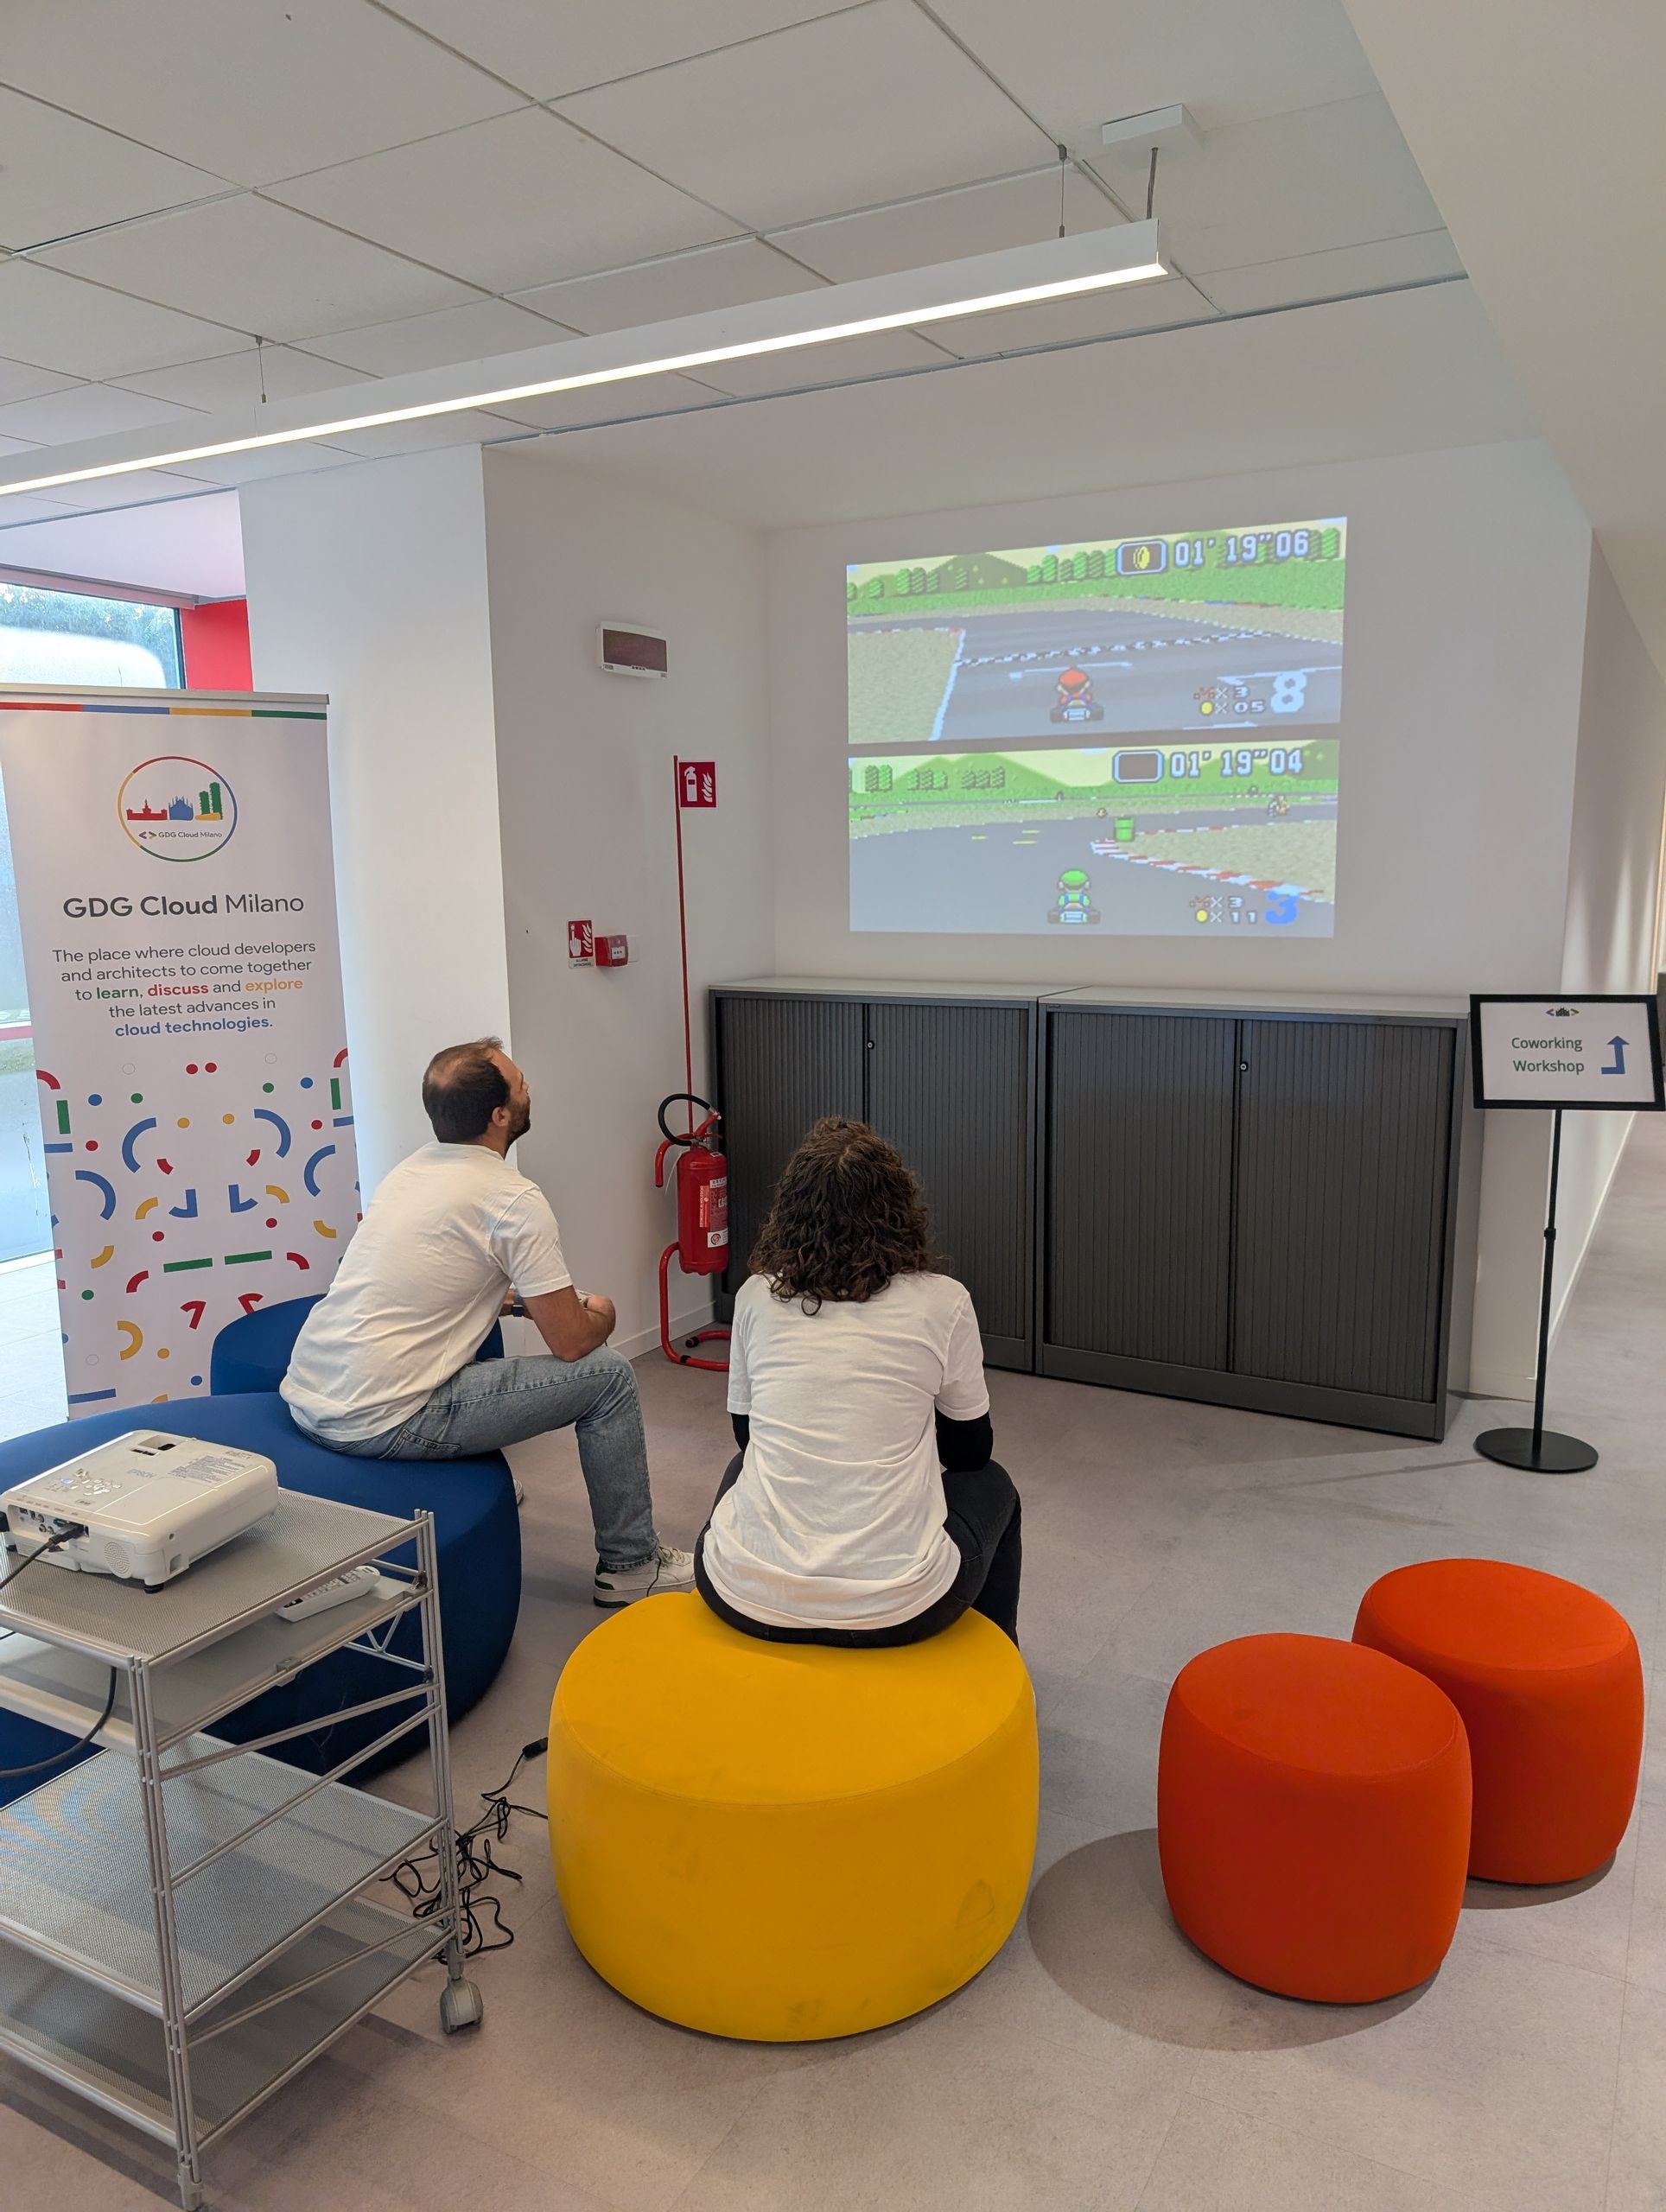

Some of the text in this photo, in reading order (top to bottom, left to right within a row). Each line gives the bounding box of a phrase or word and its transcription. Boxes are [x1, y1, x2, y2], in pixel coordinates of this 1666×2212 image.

[1270, 671, 1307, 713] 8
[63, 893, 304, 918] GDG Cloud Milano
[53, 941, 316, 964] The place where cloud developers
[61, 958, 312, 982] and architects to come together
[75, 977, 303, 1001] to learn, discuss and explore
[109, 997, 276, 1018] the latest advances in
[115, 1016, 273, 1037] cloud technologies.
[1511, 1037, 1582, 1052] Coworking
[1513, 1060, 1585, 1075] Workshop
